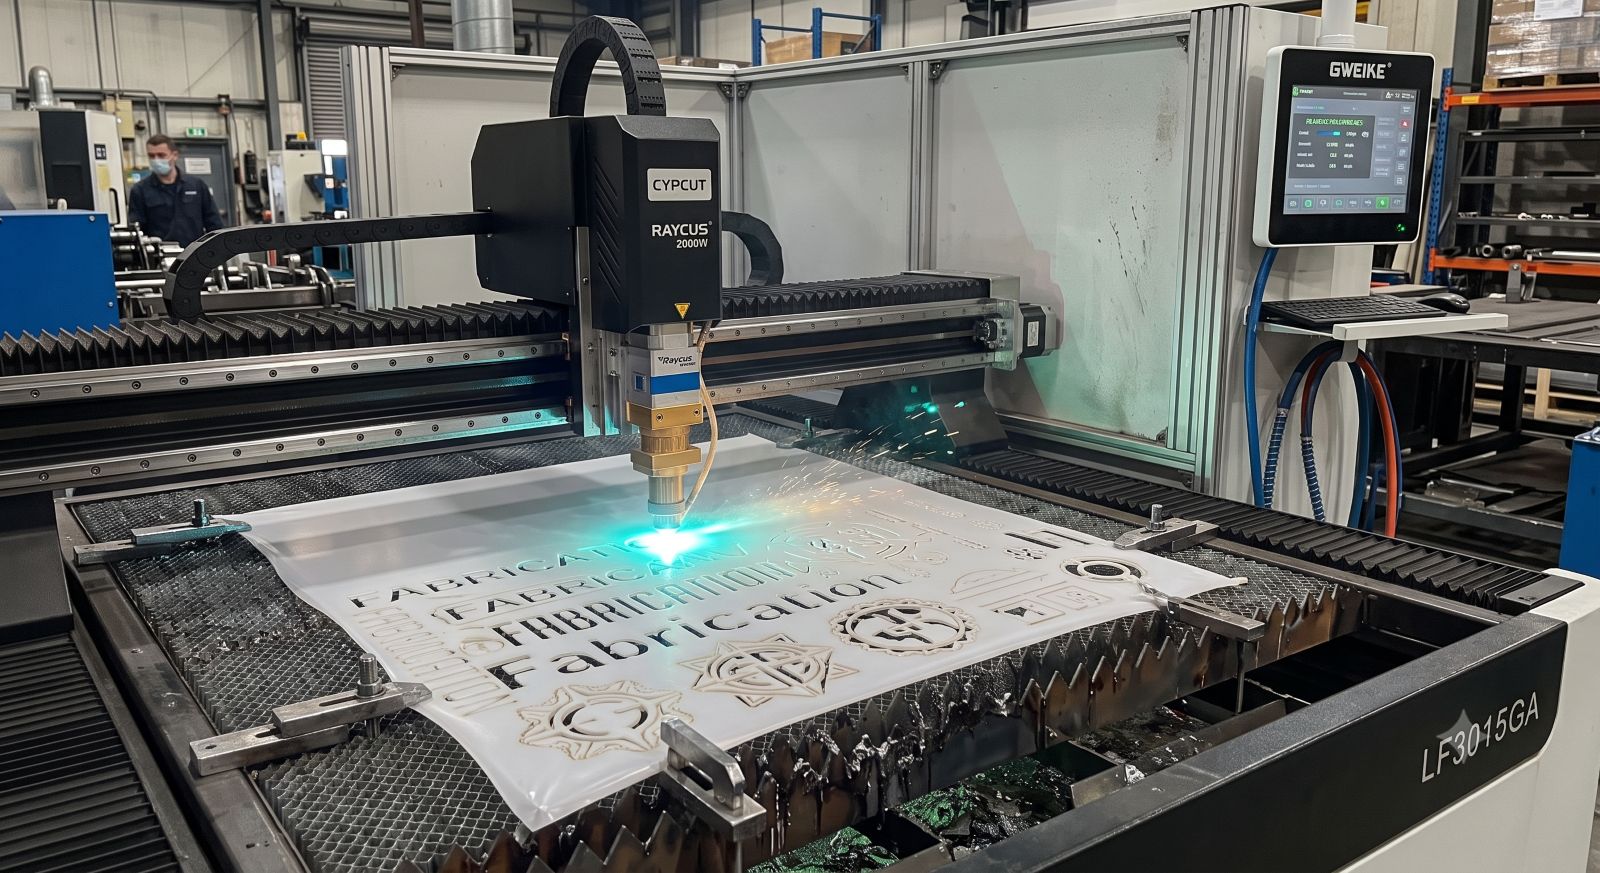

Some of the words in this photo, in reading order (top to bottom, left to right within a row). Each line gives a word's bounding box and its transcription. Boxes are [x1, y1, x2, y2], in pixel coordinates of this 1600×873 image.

[652, 179, 707, 191] CYPCUT
[676, 238, 708, 249] 2000W
[662, 355, 693, 365] Raycus
[486, 573, 908, 691] Fabrication
[1420, 691, 1540, 784] LF3015GA
